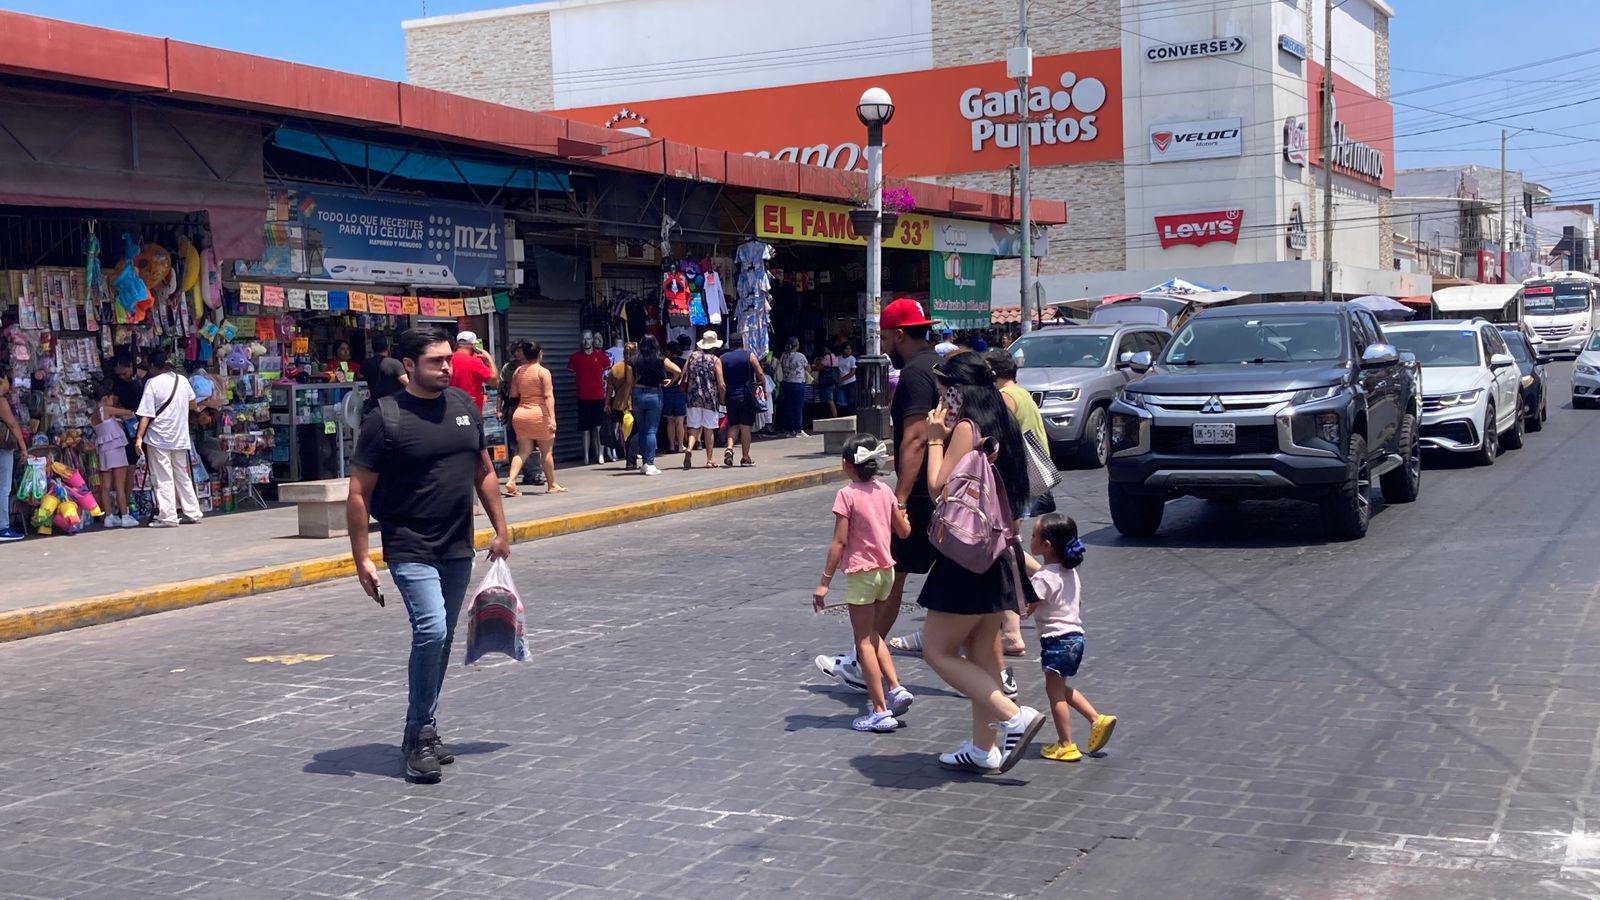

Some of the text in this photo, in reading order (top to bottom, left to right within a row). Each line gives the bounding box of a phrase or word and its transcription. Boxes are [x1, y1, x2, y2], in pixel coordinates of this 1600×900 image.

[1147, 40, 1228, 60] CONVERSE
[959, 86, 1051, 120] Gana
[971, 113, 1098, 152] Puntos
[1174, 129, 1239, 143] VELOCI
[1336, 120, 1385, 180] Hermanos
[317, 210, 424, 229] TODO LO QUE NECESITES
[339, 224, 424, 240] PARA TU CELULAR
[763, 205, 794, 235] EL
[454, 224, 498, 251] mzt
